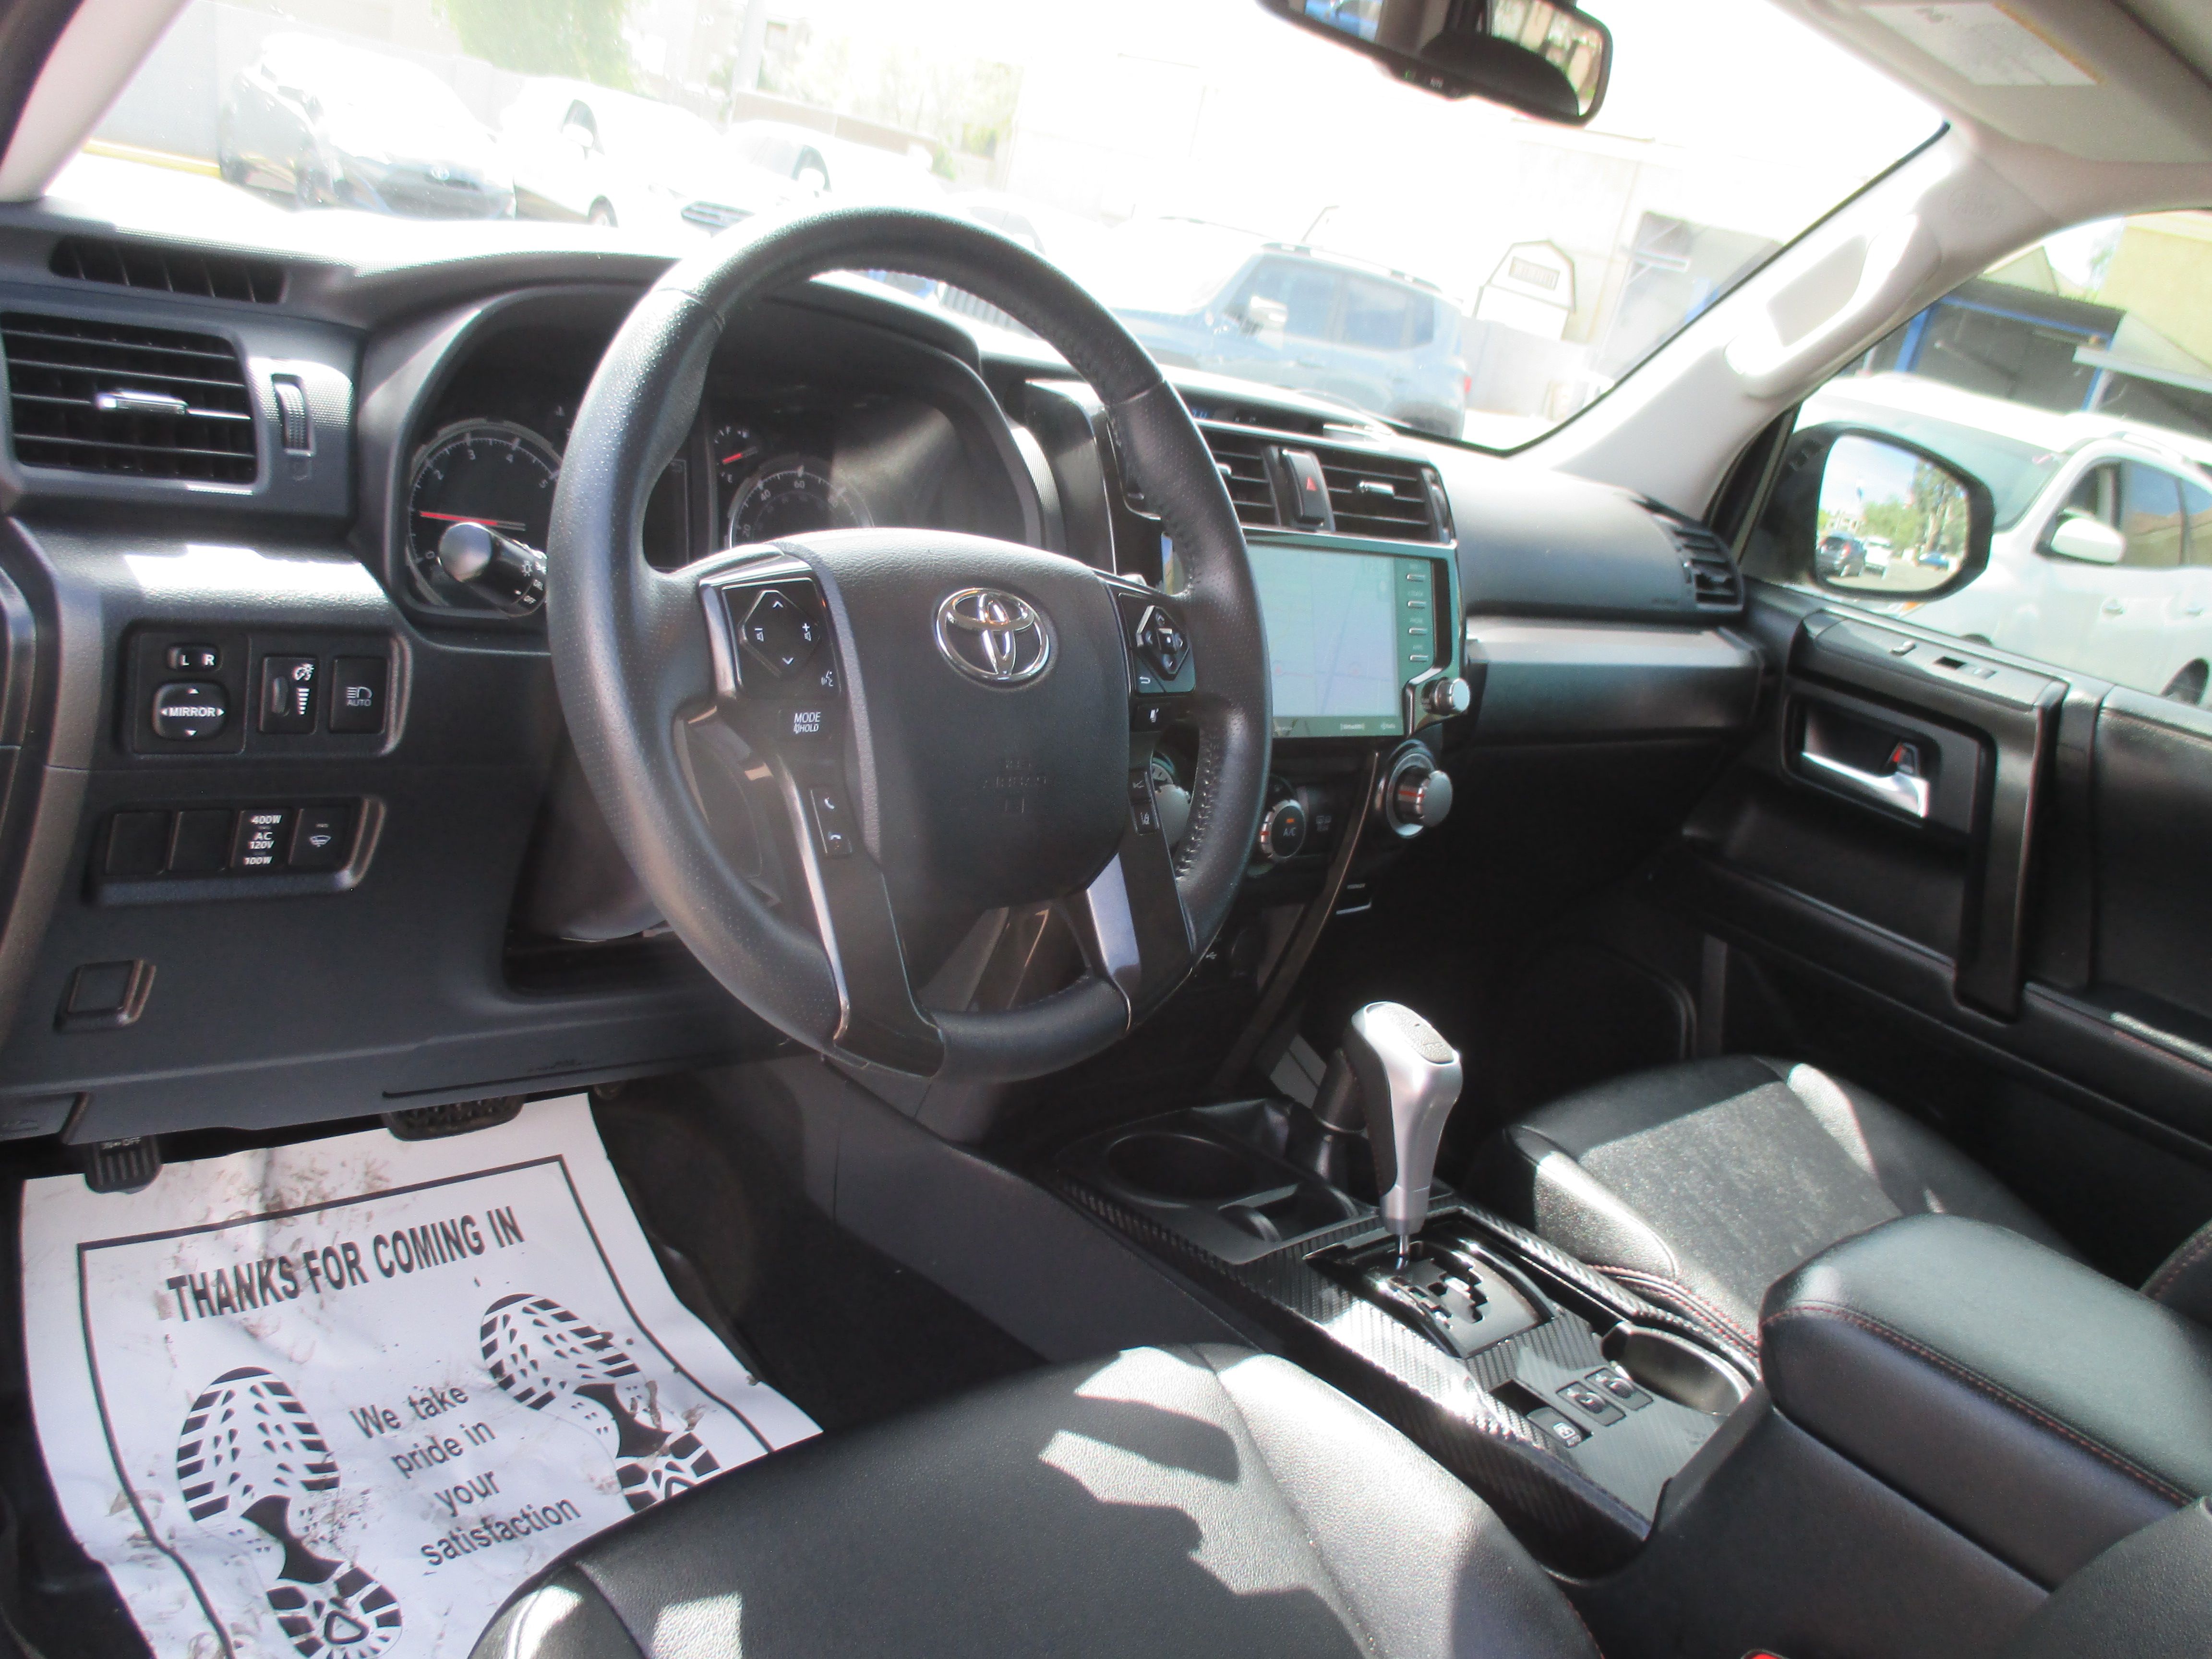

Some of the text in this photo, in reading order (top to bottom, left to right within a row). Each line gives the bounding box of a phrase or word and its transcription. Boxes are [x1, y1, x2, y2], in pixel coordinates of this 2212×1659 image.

[180, 653, 215, 666] L R
[168, 707, 216, 718] MIRROR
[794, 711, 820, 723] MODE
[800, 724, 819, 732] HOLD
[251, 815, 282, 824] 400W
[254, 832, 272, 841] AC
[1283, 827, 1296, 837] A/C
[250, 841, 274, 849] 120V
[244, 856, 273, 865] 100W
[167, 1205, 525, 1322] THANKS FOR COMING IN
[349, 1386, 469, 1439] We take
[391, 1419, 496, 1479] pride in
[434, 1469, 500, 1518] your
[420, 1495, 582, 1567] satisfaction
